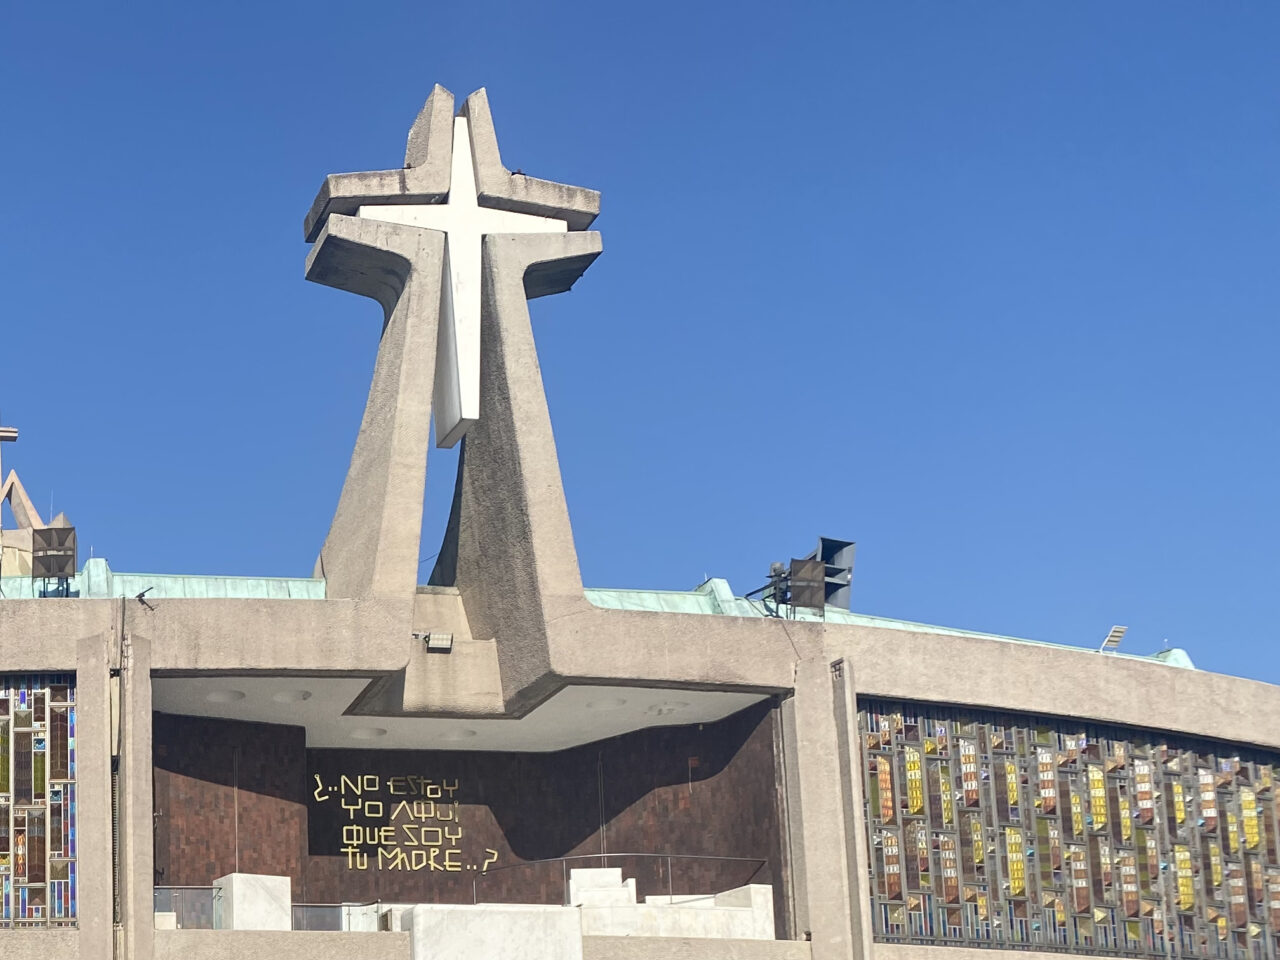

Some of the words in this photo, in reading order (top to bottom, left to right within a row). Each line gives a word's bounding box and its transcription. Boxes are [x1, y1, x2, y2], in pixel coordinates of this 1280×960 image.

[342, 798, 383, 820] YO
[342, 824, 397, 847] QUE
[402, 824, 463, 846] SOY
